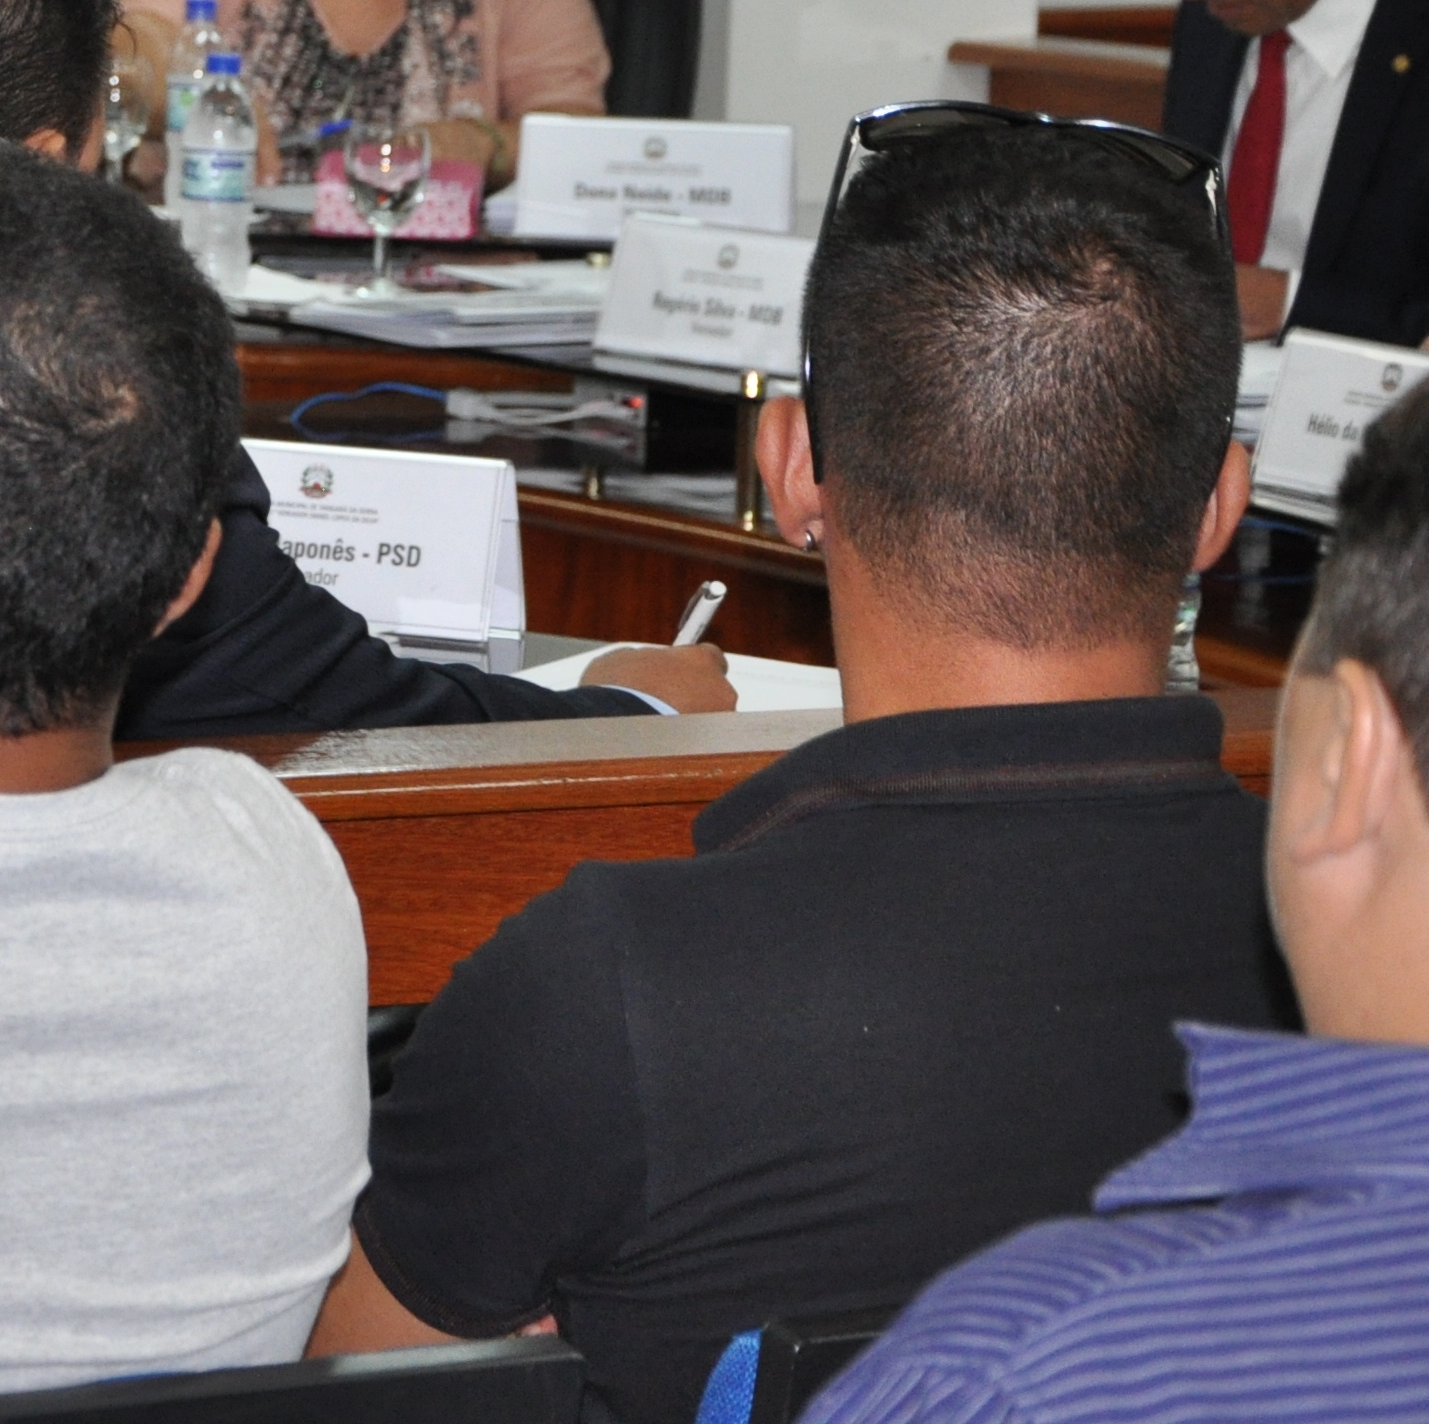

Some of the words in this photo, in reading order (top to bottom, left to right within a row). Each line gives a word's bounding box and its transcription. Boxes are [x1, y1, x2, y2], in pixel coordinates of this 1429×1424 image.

[1307, 413, 1340, 438] Hélio
[279, 537, 356, 563] aponês
[376, 542, 422, 568] PSD
